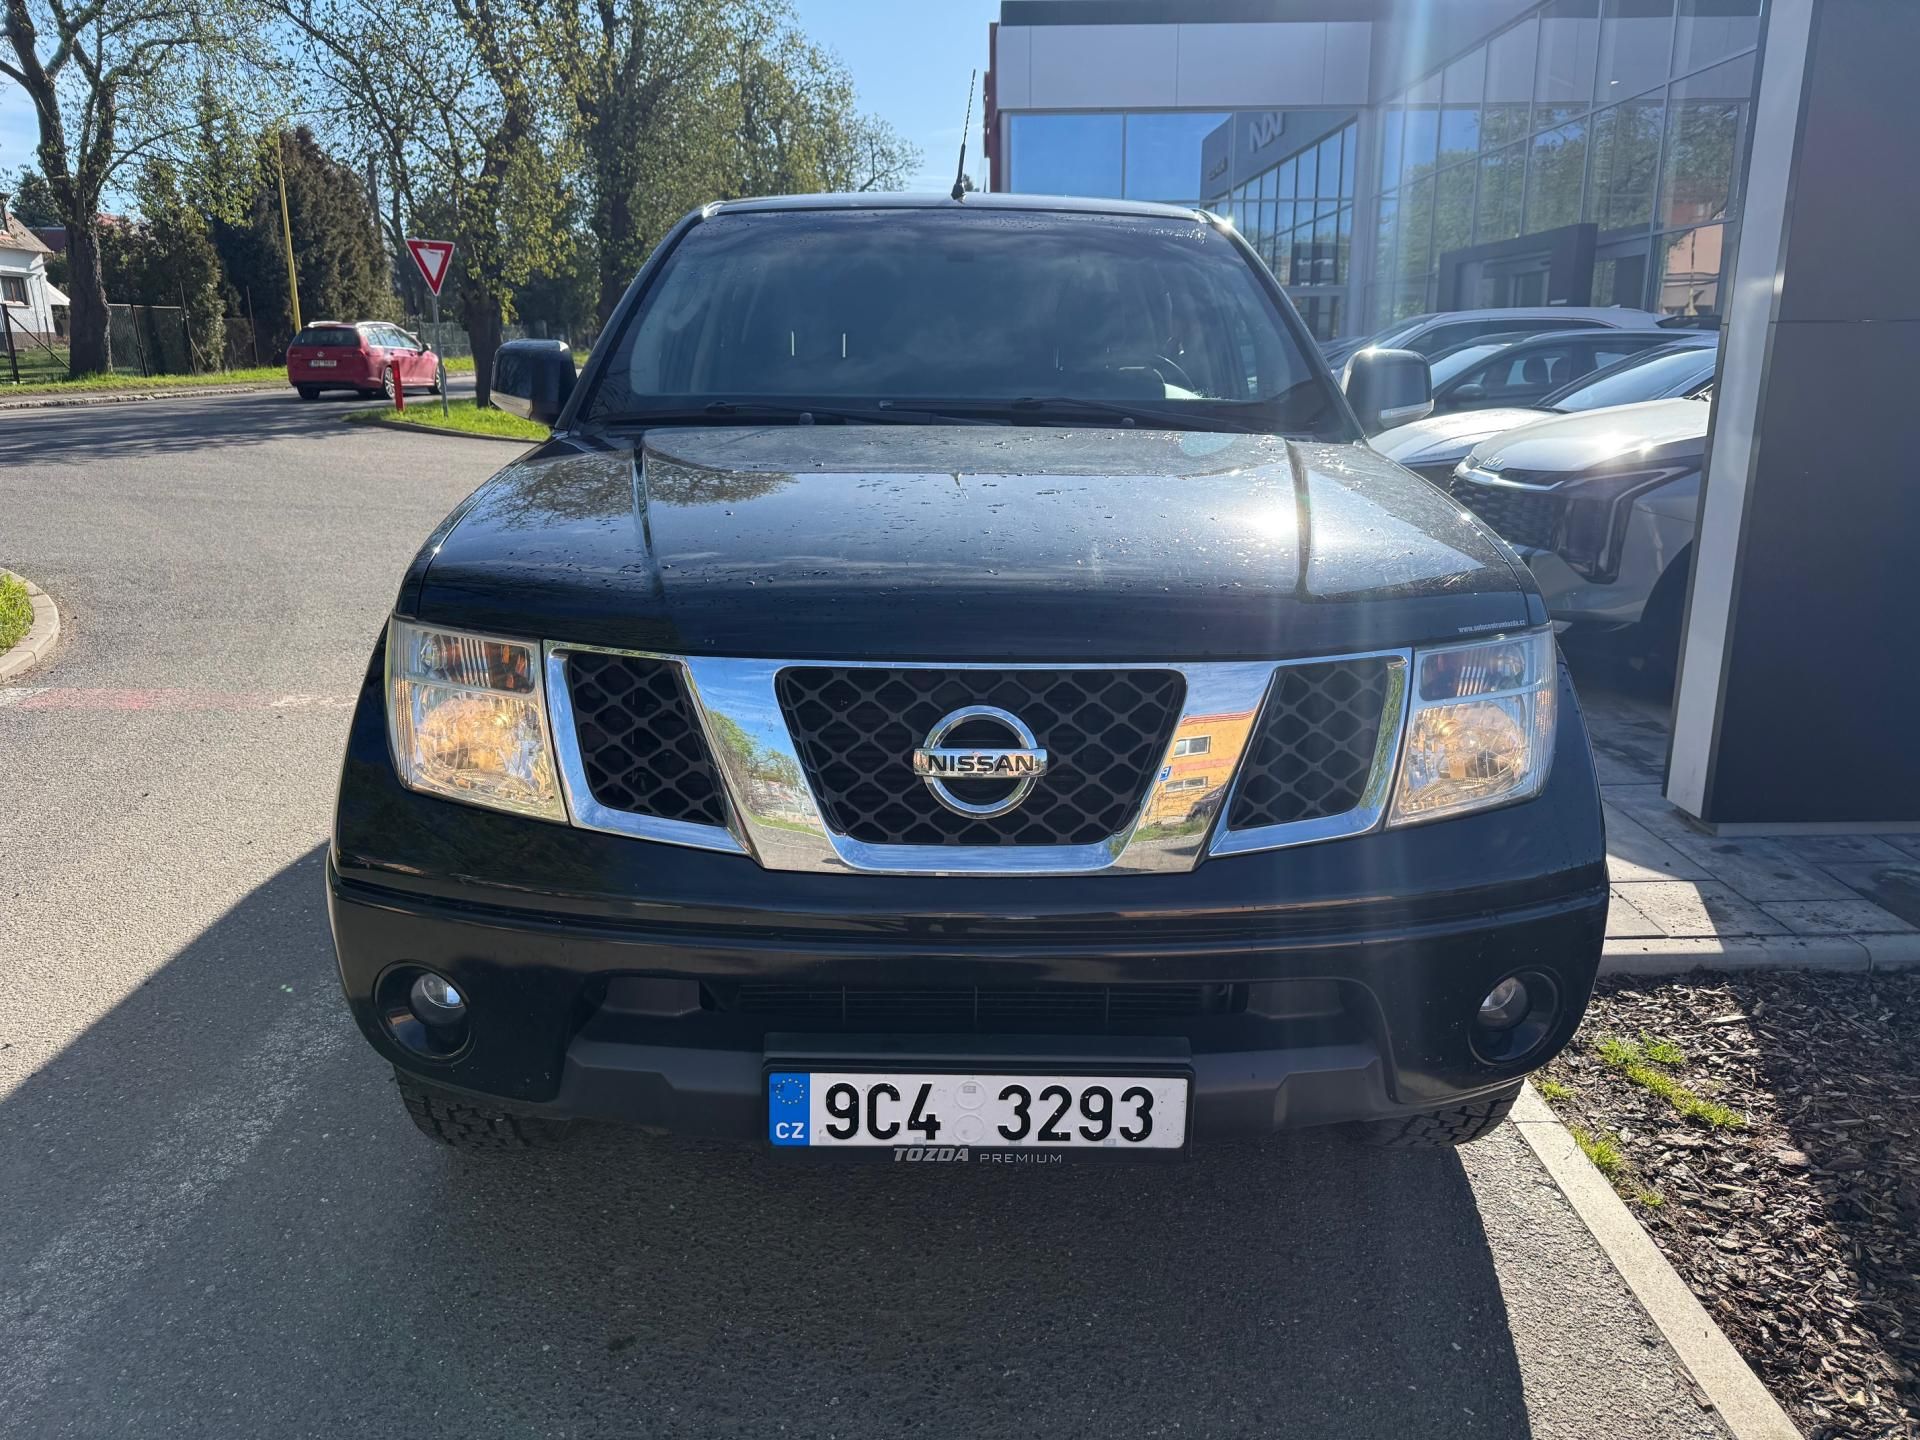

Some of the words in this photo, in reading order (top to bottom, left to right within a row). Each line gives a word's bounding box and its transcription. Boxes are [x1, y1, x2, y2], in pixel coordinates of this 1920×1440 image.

[928, 755, 1034, 772] NISSAN
[775, 1122, 805, 1139] CZ
[825, 1082, 941, 1140] 9C4
[997, 1084, 1154, 1142] 3293
[893, 1147, 969, 1162] TOZDA
[979, 1153, 1063, 1163] PREMIUM
